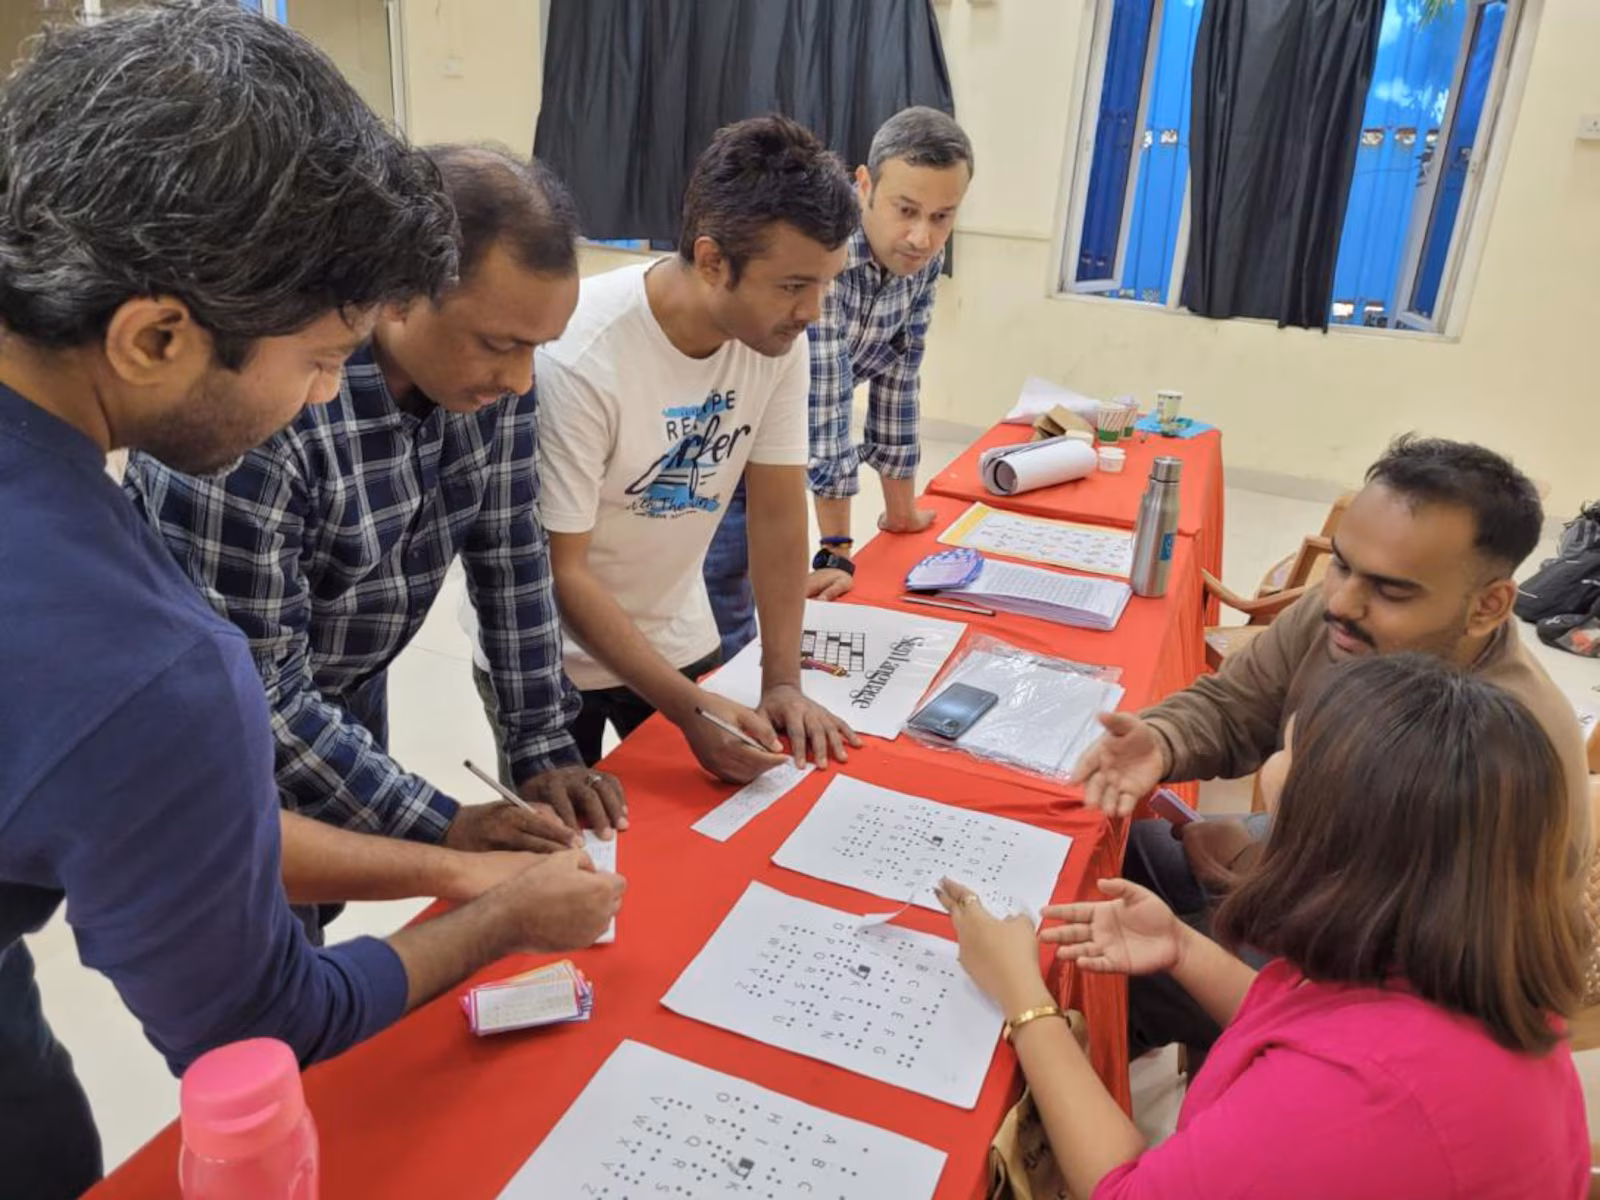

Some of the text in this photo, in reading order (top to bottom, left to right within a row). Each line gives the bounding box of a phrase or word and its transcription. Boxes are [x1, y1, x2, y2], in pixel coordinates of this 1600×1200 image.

[581, 1097, 664, 1195] V W X Y Z
[655, 1092, 730, 1192] O P Q R S
[767, 1113, 783, 1125] H
[725, 1181, 740, 1191] K
[797, 1134, 837, 1192] A B C
